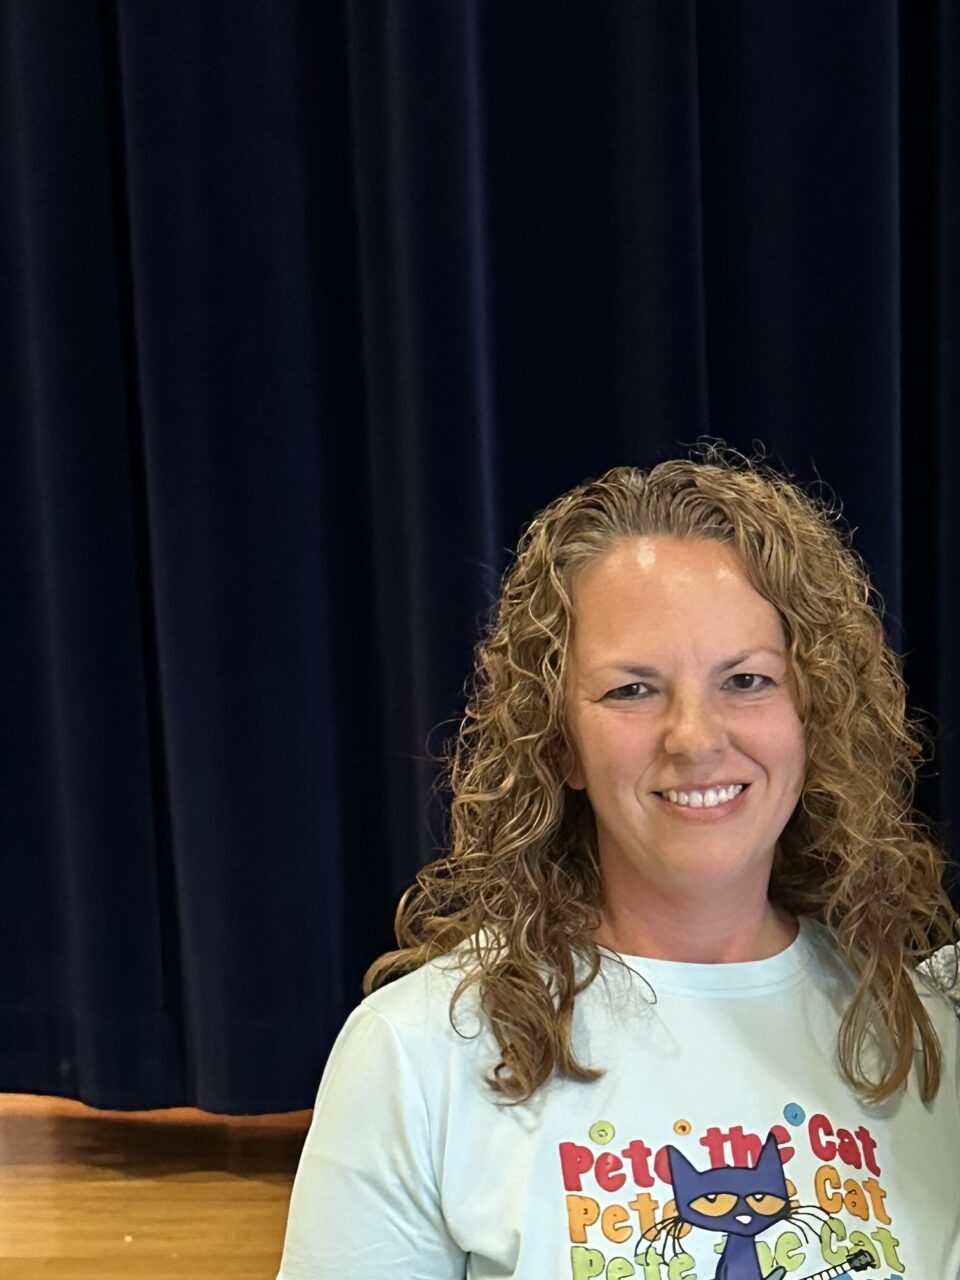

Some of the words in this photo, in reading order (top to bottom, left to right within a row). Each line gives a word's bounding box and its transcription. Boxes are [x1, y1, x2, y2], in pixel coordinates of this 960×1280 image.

[808, 1113, 882, 1178] Cat
[814, 1164, 893, 1226] Cat
[820, 1217, 906, 1274] Cat
